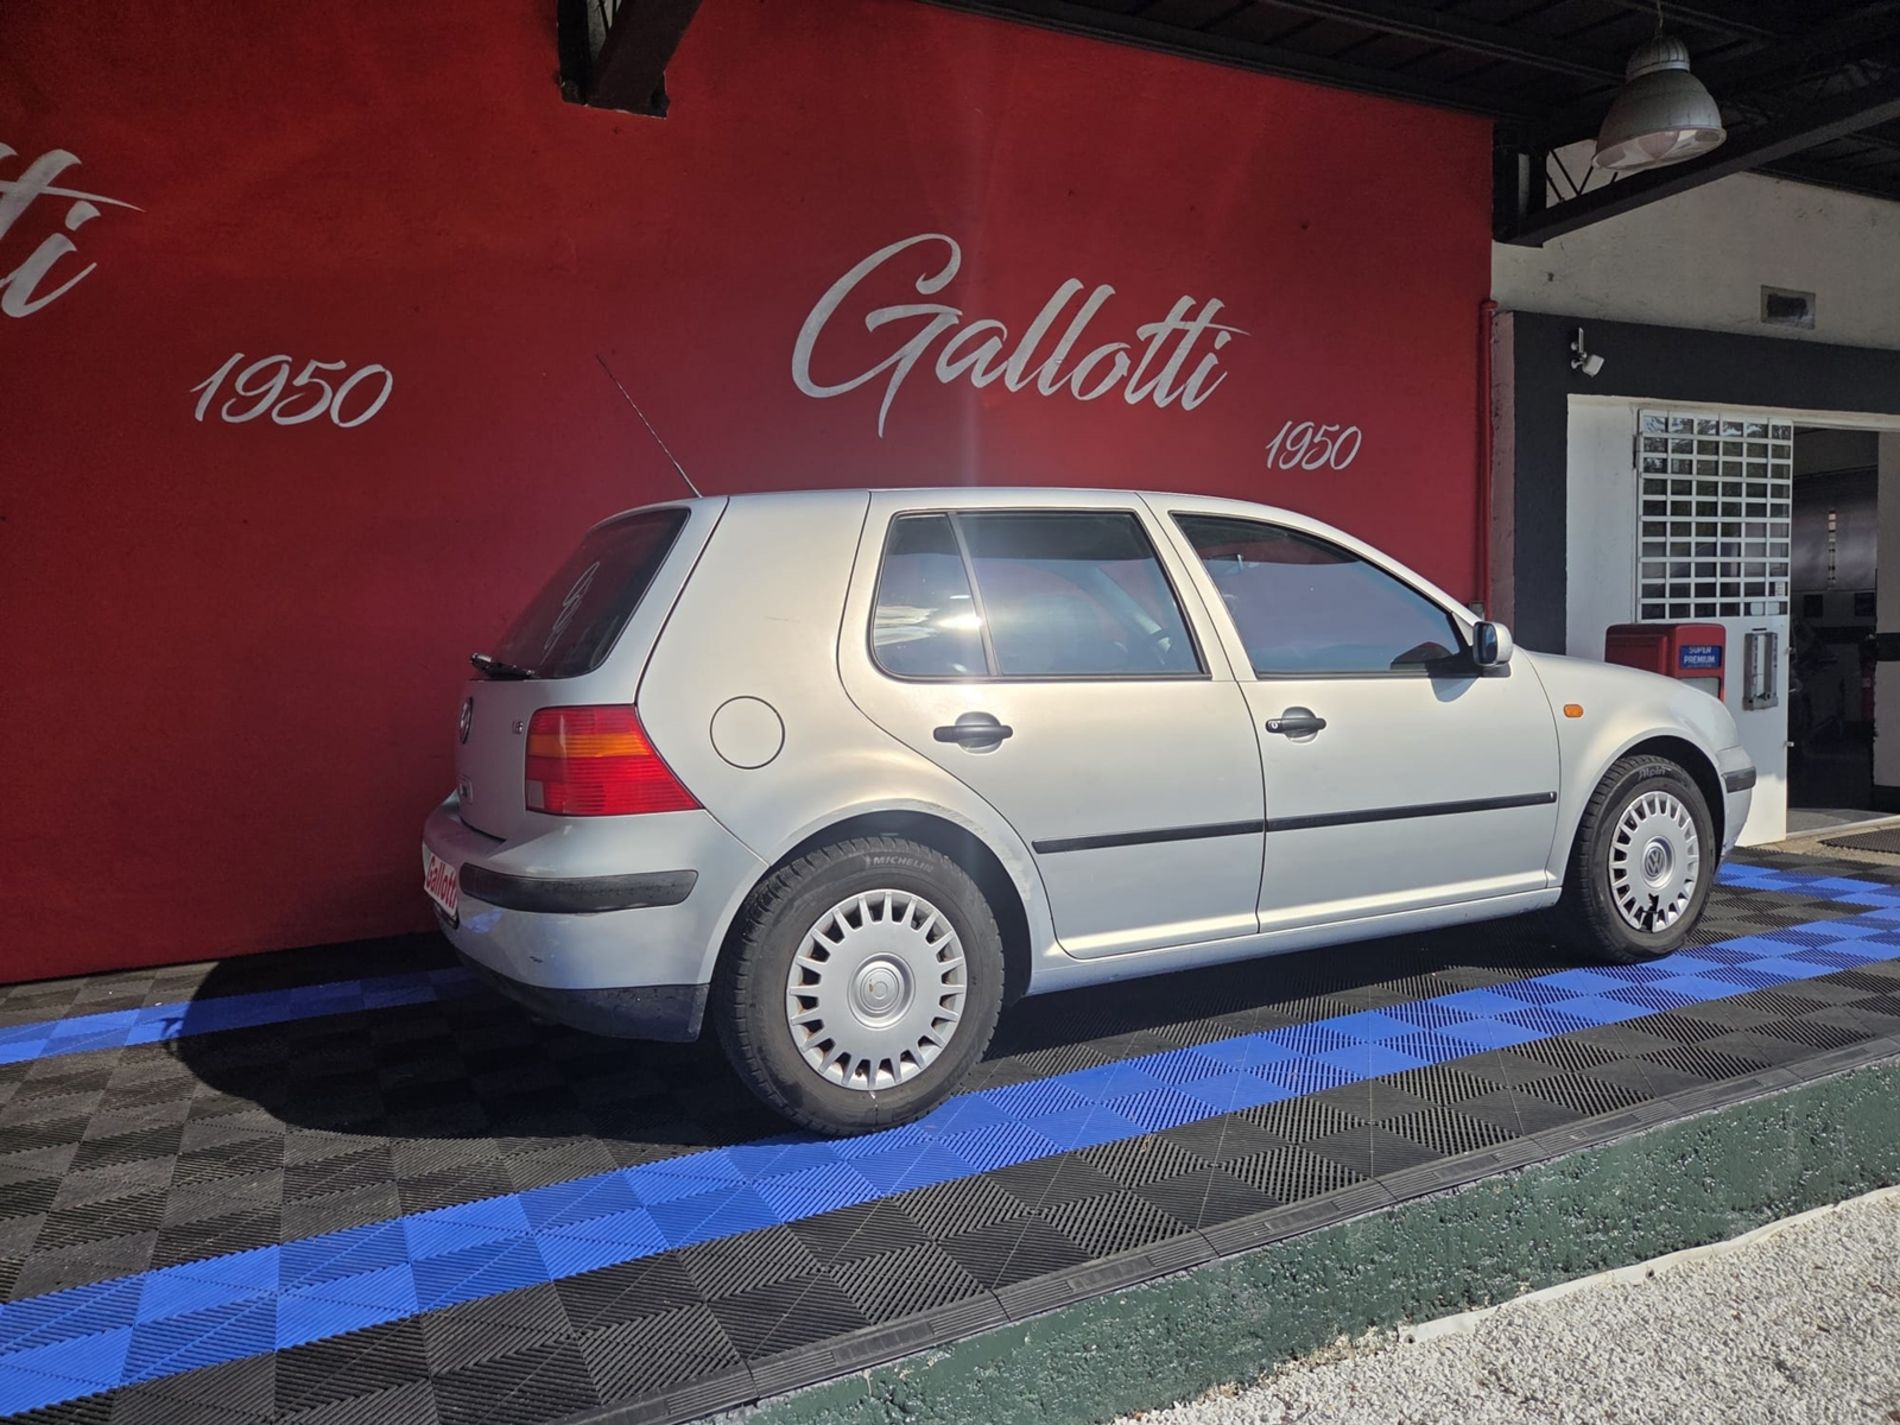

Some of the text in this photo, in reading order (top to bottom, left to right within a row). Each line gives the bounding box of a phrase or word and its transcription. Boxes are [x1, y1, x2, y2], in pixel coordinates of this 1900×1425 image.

[792, 233, 1251, 438] Gallotti
[190, 353, 393, 428] 1950
[1266, 420, 1362, 470] 1950
[1683, 655, 1716, 664] PREMIUM
[873, 855, 934, 873] MICHELIN
